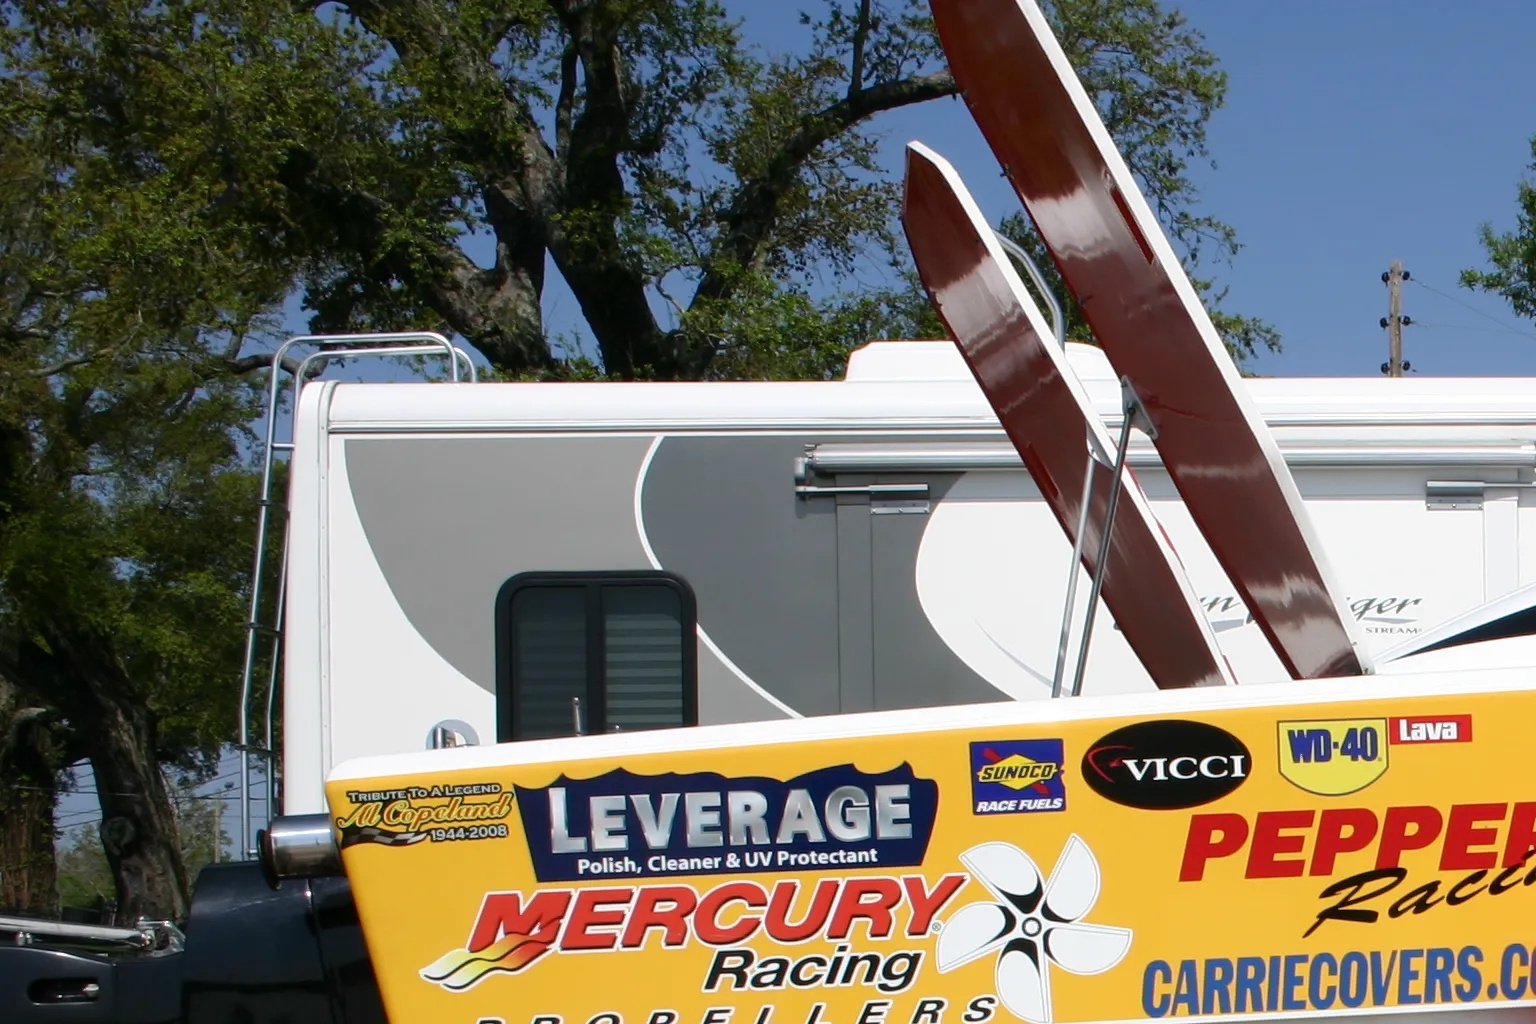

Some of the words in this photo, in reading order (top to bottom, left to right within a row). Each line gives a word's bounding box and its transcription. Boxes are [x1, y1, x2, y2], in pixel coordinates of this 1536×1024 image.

[1287, 723, 1380, 764] WD-40
[1398, 718, 1459, 742] Lava
[980, 764, 1054, 781] SUNOCO
[1121, 754, 1247, 782] VICCI
[348, 790, 407, 802] TRIBUTE
[430, 786, 443, 797] A
[445, 784, 501, 796] LEGEND
[976, 800, 1018, 813] RACE
[1018, 798, 1064, 811] FUELS
[383, 793, 513, 833] Copeland
[549, 783, 914, 855] LEVERAGE
[430, 825, 508, 842] 1944-2008
[577, 857, 643, 875] Polish,
[648, 855, 722, 872] Cleaner
[725, 853, 741, 868] &
[744, 851, 773, 867] UV
[777, 848, 878, 866] Protectant
[467, 874, 970, 954] MERCURY
[703, 945, 924, 993] Racing
